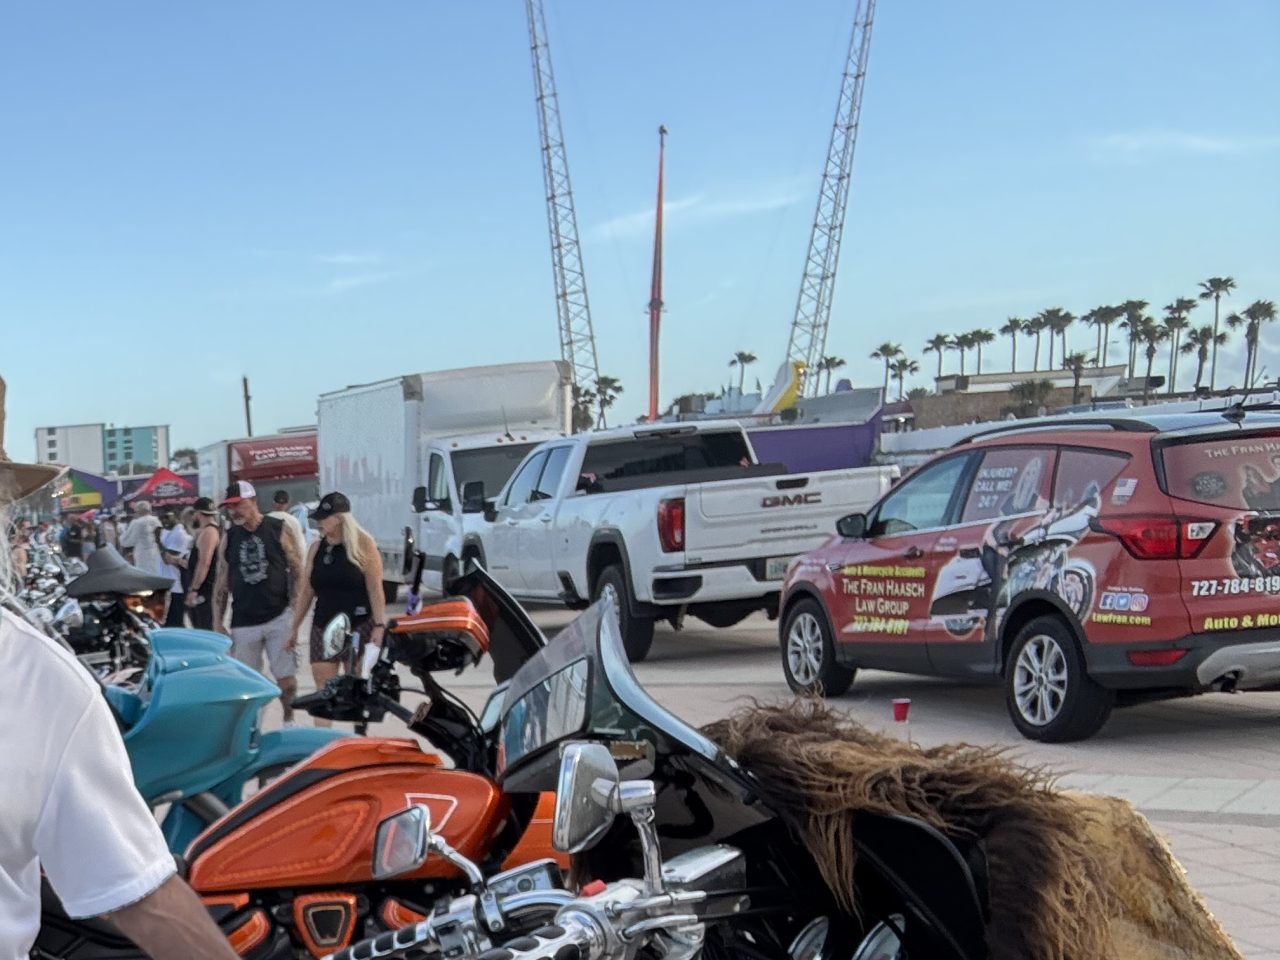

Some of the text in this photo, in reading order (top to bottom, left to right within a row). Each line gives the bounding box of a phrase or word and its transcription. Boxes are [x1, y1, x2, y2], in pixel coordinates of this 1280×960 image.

[1204, 448, 1229, 458] THE
[1231, 444, 1264, 456] FRAN
[975, 480, 994, 492] CALL
[762, 491, 822, 508] GMC
[842, 578, 925, 597] THE FRAN HAASCH
[855, 597, 909, 615] LAW GROUP
[1203, 615, 1238, 630] Auto
[1241, 614, 1254, 627] &
